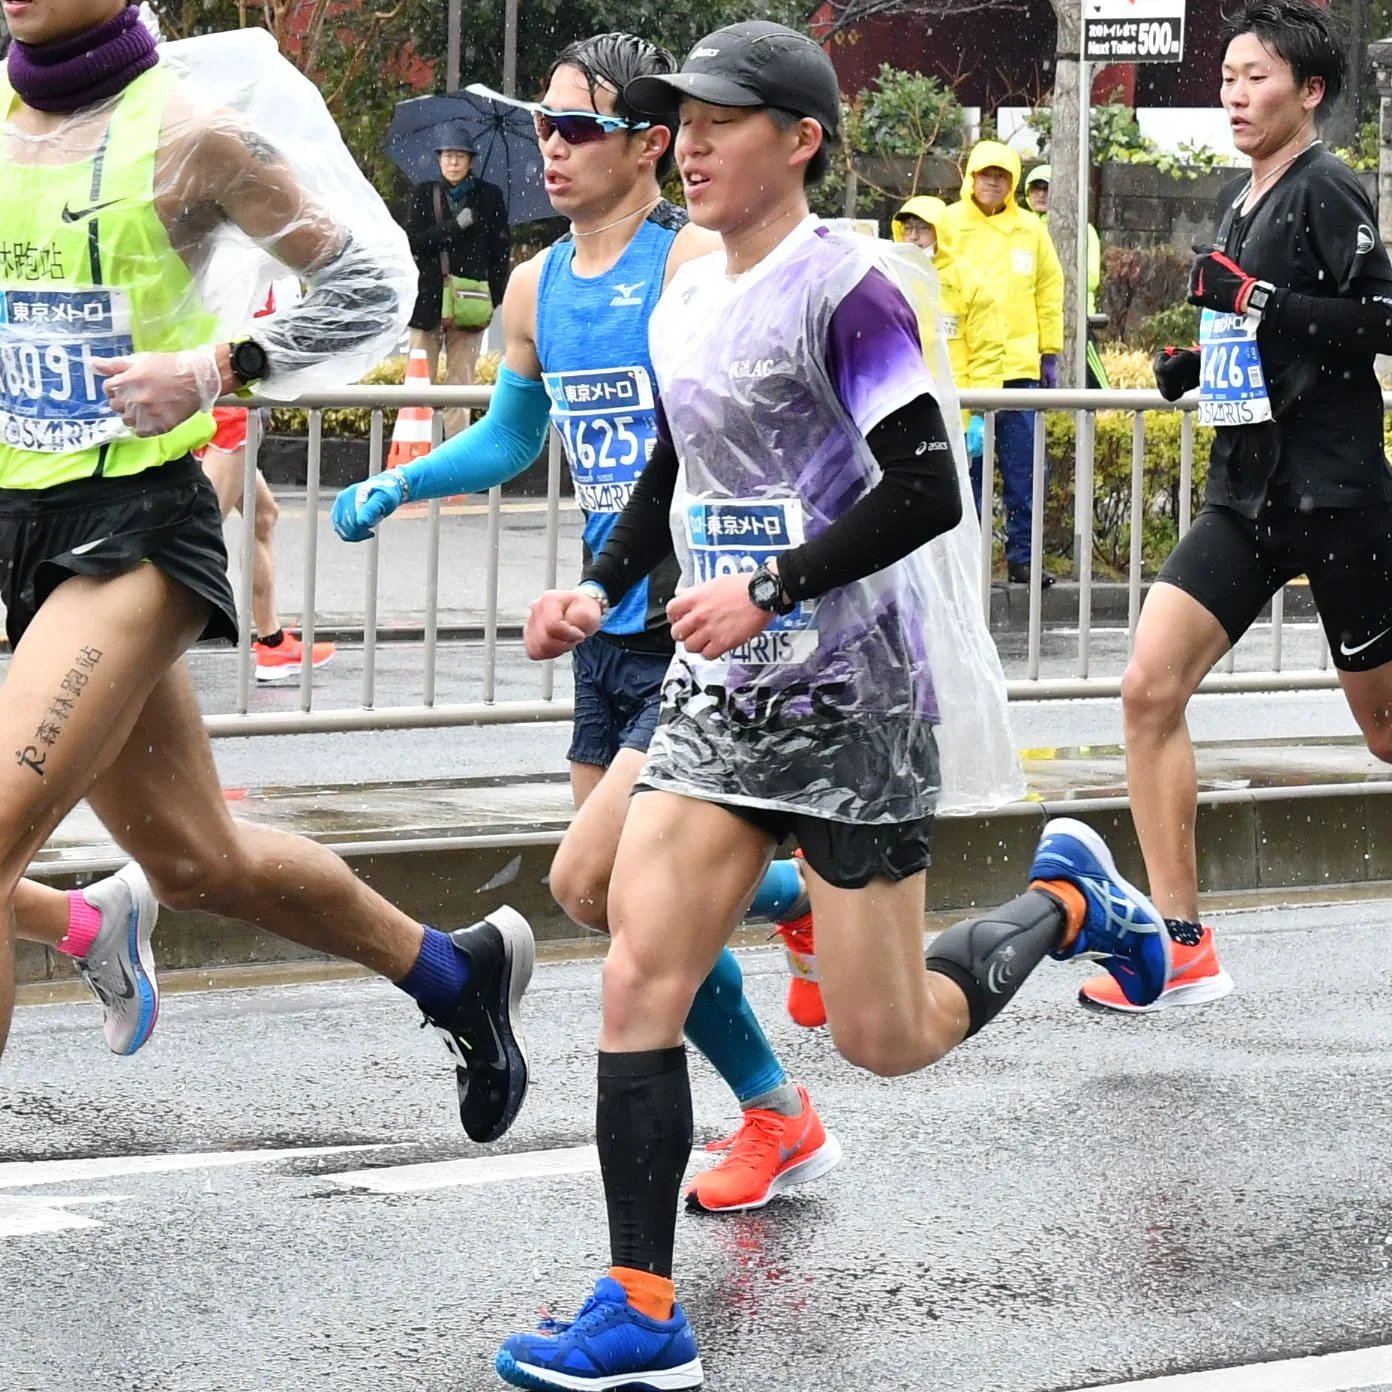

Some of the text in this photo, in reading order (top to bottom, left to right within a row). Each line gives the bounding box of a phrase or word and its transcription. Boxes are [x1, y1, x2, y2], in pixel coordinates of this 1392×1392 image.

[1088, 40, 1136, 55] Next Toilet
[12, 301, 103, 322] 東京メトロ
[565, 381, 632, 404] 東京メトロ
[707, 515, 781, 536] 東京メトロ
